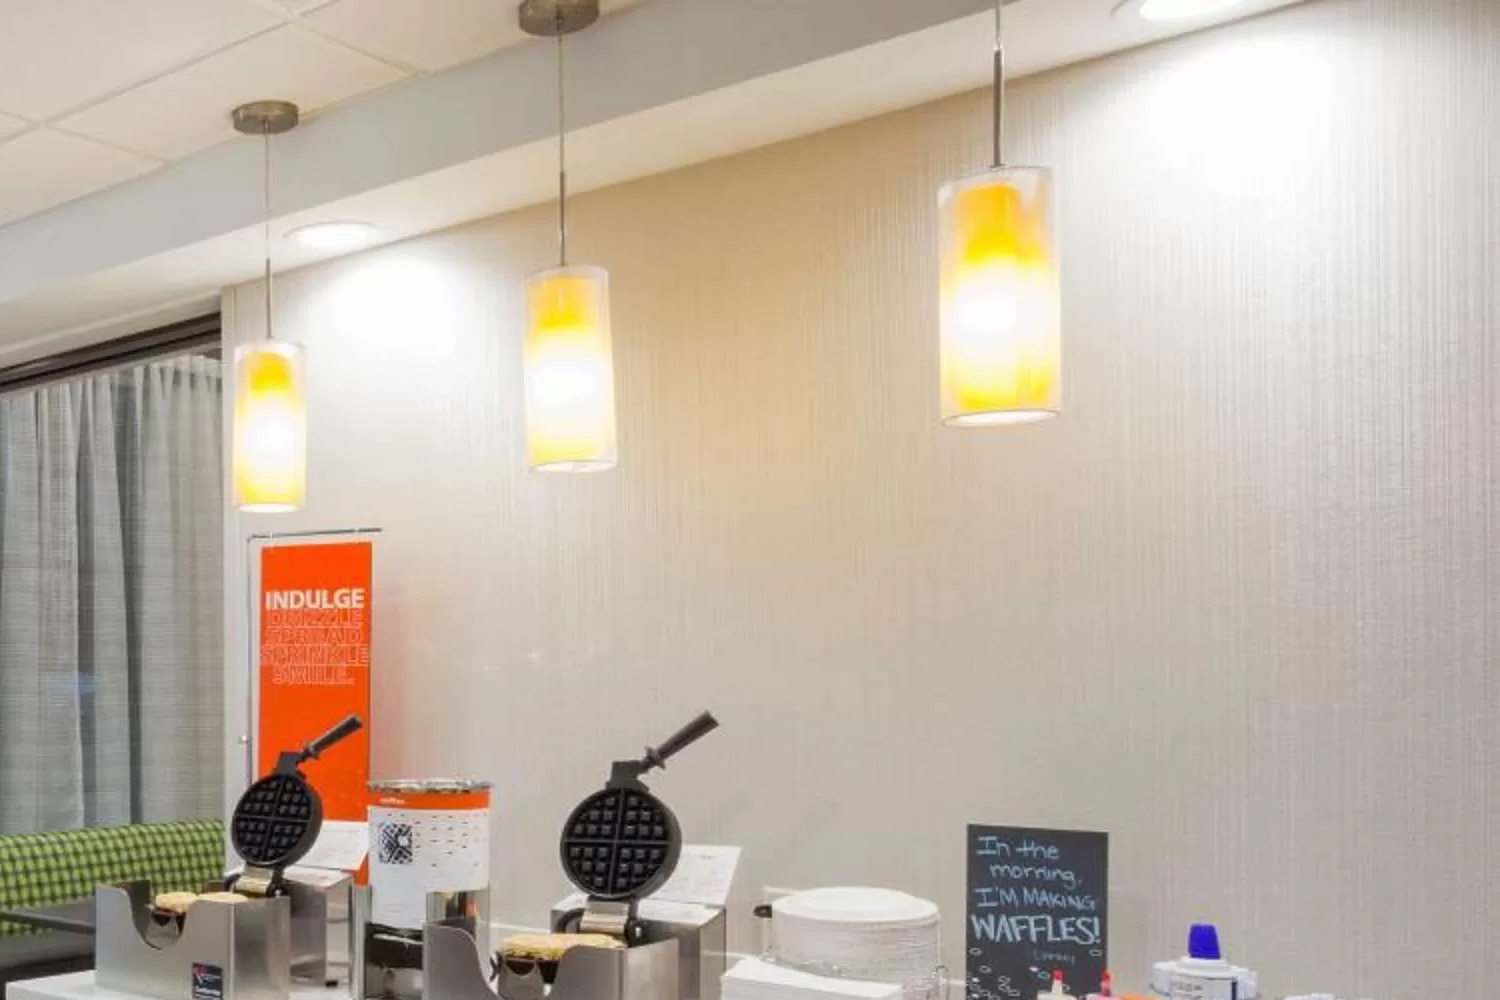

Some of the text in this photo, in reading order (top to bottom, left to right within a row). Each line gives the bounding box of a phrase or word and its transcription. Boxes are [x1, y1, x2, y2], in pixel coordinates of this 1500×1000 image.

[265, 588, 365, 610] INDULGE
[976, 836, 1060, 860] In the
[974, 886, 1096, 911] I'M MAKING
[970, 913, 1101, 945] WAFFLES!
